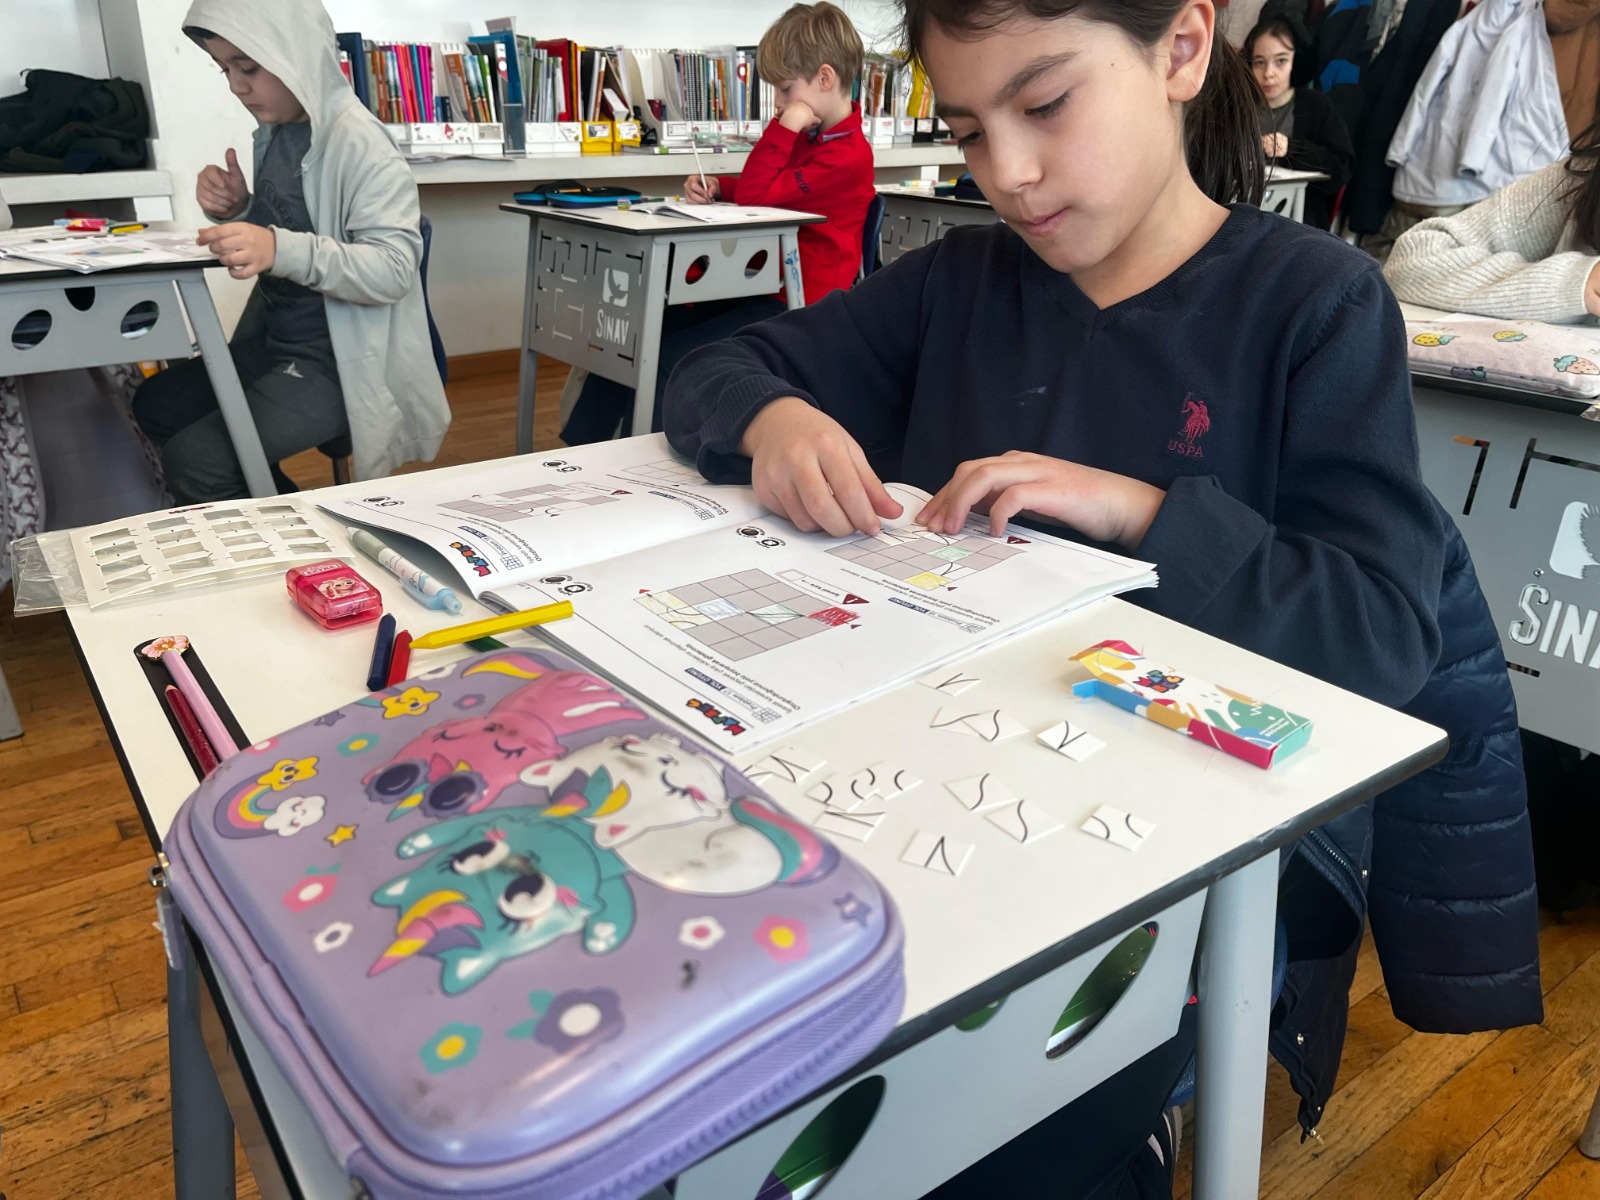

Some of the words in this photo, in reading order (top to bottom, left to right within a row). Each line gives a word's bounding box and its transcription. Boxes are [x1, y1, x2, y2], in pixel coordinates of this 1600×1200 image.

[596, 309, 630, 346] SINAV
[1167, 439, 1204, 458] USPA
[1509, 584, 1600, 669] SIN
